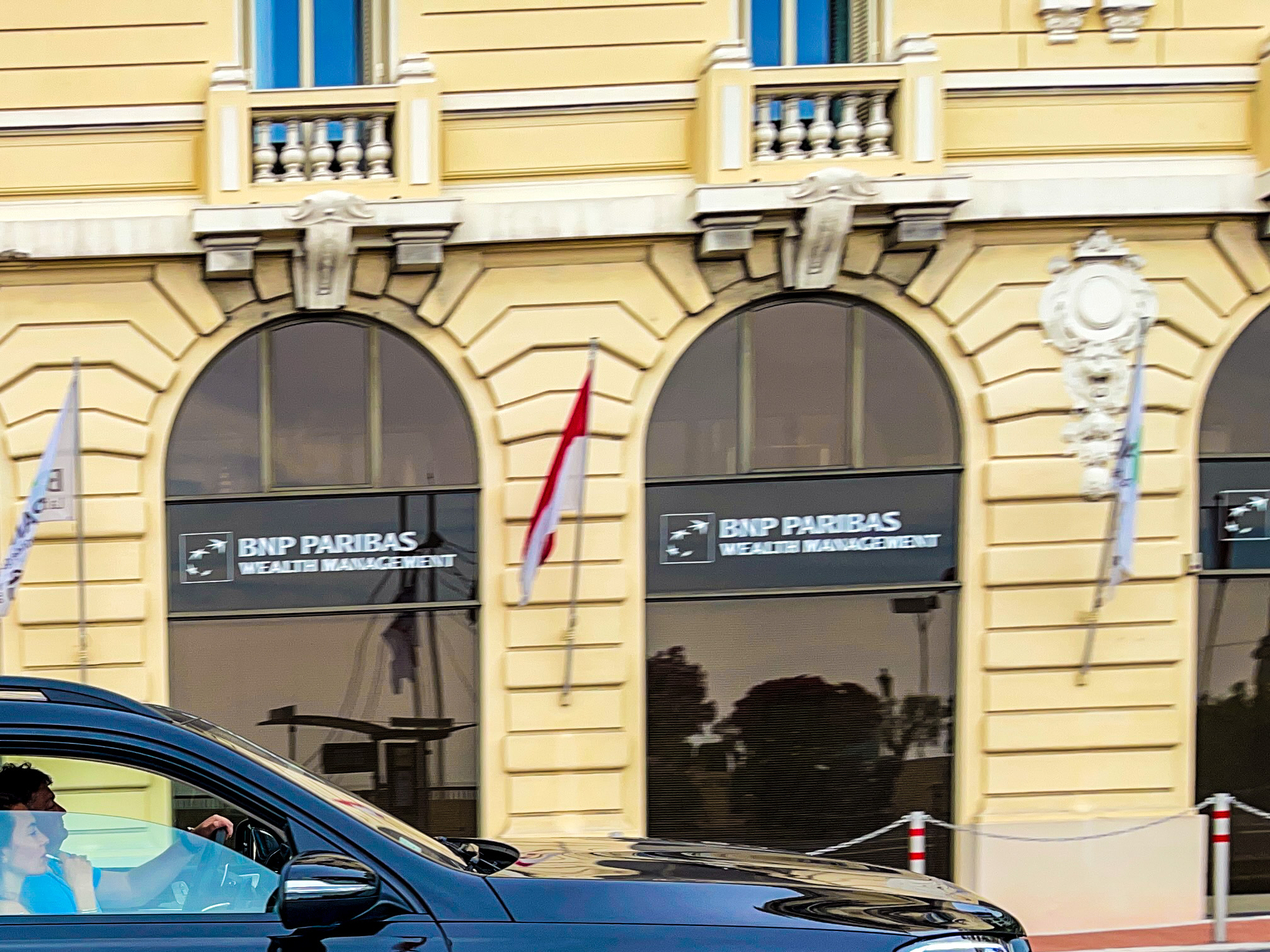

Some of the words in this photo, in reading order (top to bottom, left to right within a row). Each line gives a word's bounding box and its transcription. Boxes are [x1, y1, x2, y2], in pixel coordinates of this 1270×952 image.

[719, 517, 779, 539] BNP
[782, 511, 902, 536] PARIBAS
[237, 536, 297, 557] BNP
[300, 531, 418, 555] PARIBAS
[719, 540, 800, 557] WEALTH
[802, 534, 941, 553] MANAGEMENT
[238, 559, 319, 575] WEALTH
[320, 554, 457, 572] MANAGEMENT
